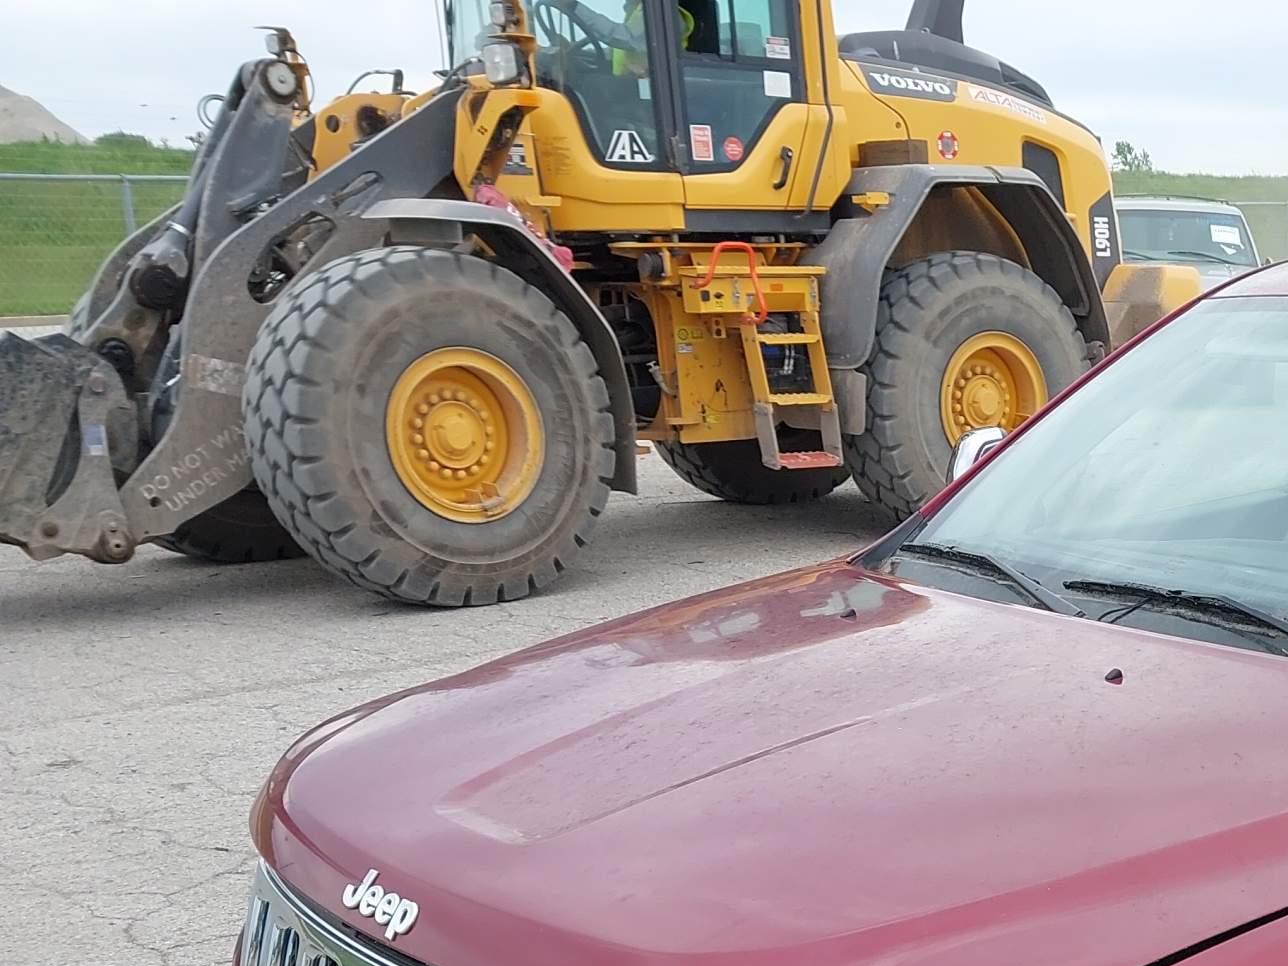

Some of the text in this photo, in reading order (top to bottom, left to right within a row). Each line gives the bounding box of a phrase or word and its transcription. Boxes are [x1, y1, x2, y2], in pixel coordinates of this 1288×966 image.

[869, 72, 950, 95] VOLVO
[974, 90, 1013, 109] ALTA
[1093, 216, 1111, 257] L90H
[139, 474, 170, 500] DO
[171, 447, 210, 479] NOT
[165, 466, 228, 512] UNDER
[342, 868, 419, 941] Jeep
